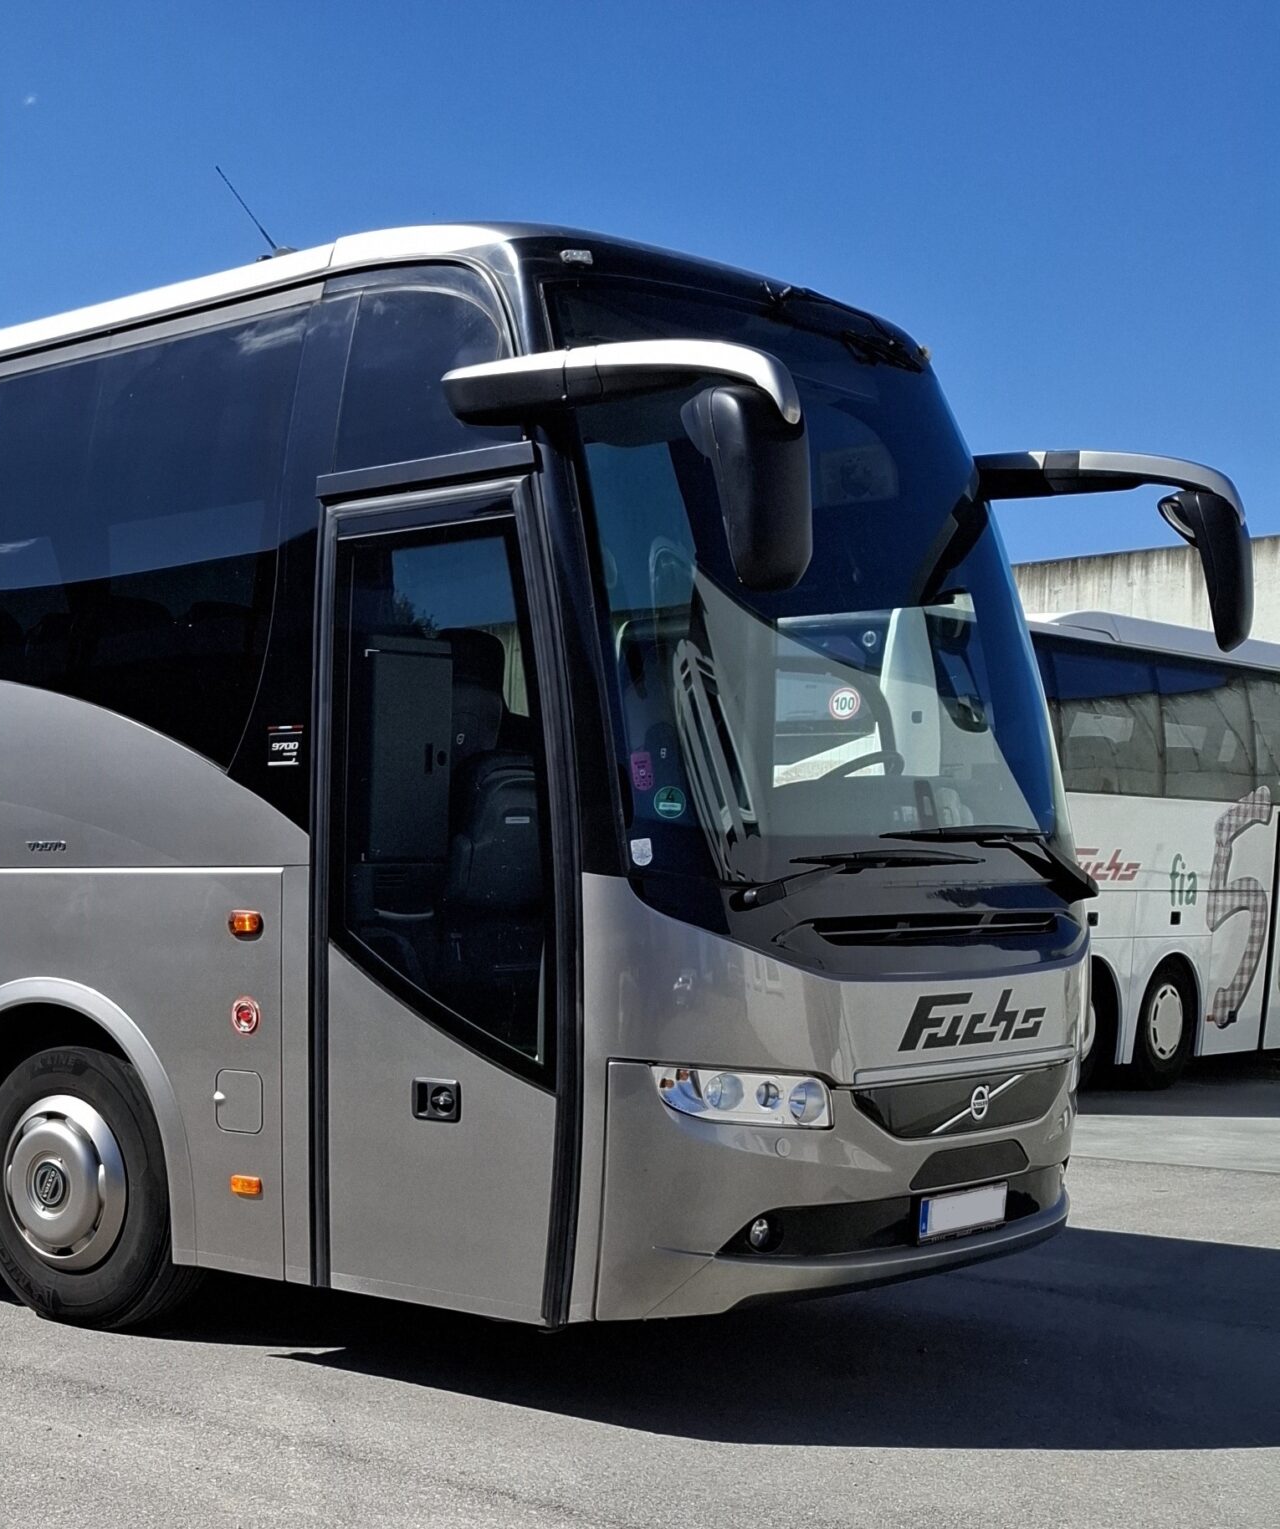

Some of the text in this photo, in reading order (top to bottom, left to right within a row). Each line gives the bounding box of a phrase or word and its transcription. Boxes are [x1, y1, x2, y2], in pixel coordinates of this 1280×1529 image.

[834, 696, 855, 711] 100
[271, 741, 299, 751] 9700
[1169, 853, 1198, 907] fia
[897, 988, 1046, 1051] Fuchs
